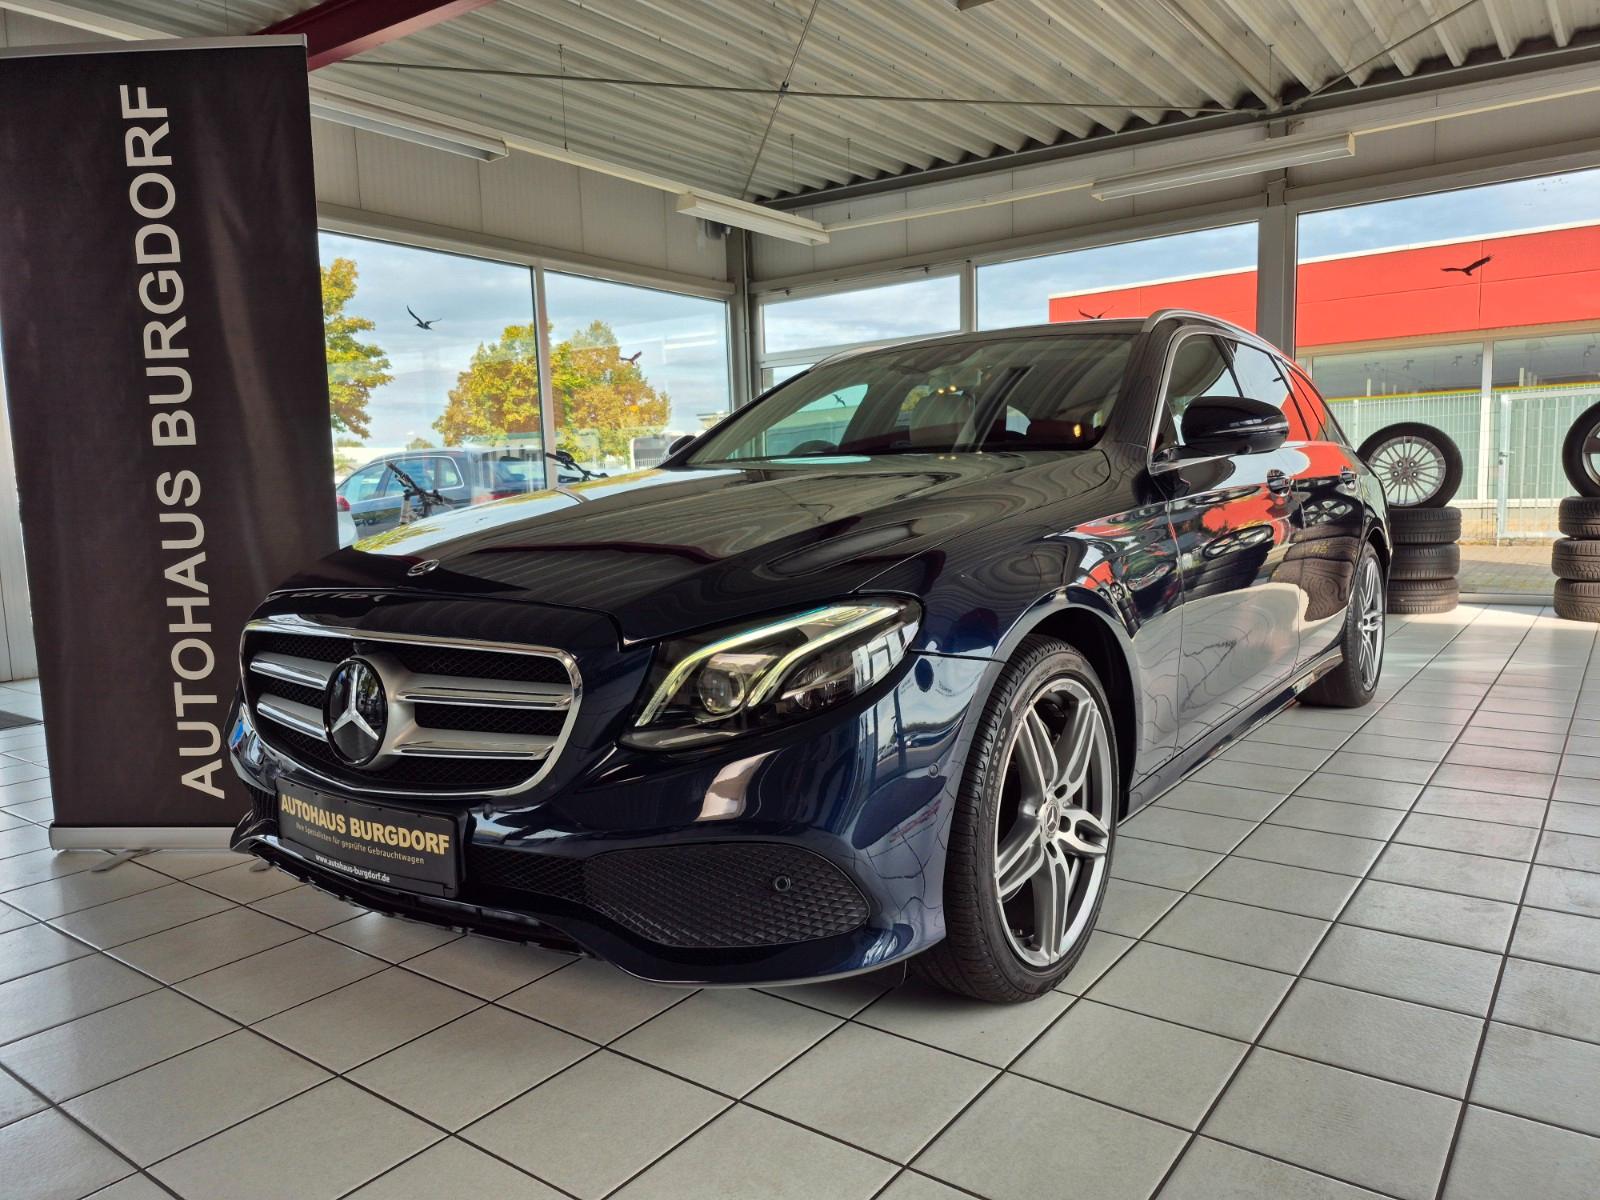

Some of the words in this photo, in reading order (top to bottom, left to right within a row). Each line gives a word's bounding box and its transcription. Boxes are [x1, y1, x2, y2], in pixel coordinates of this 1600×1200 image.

[119, 84, 197, 447] BURGDORF
[156, 469, 226, 800] AUTOHAUS
[281, 794, 346, 834] AUTOHAUS
[350, 817, 450, 856] BURGDORF
[367, 845, 425, 864] Gebrauchtwagen
[315, 854, 390, 882] www.autohaus-burgdorf.de
